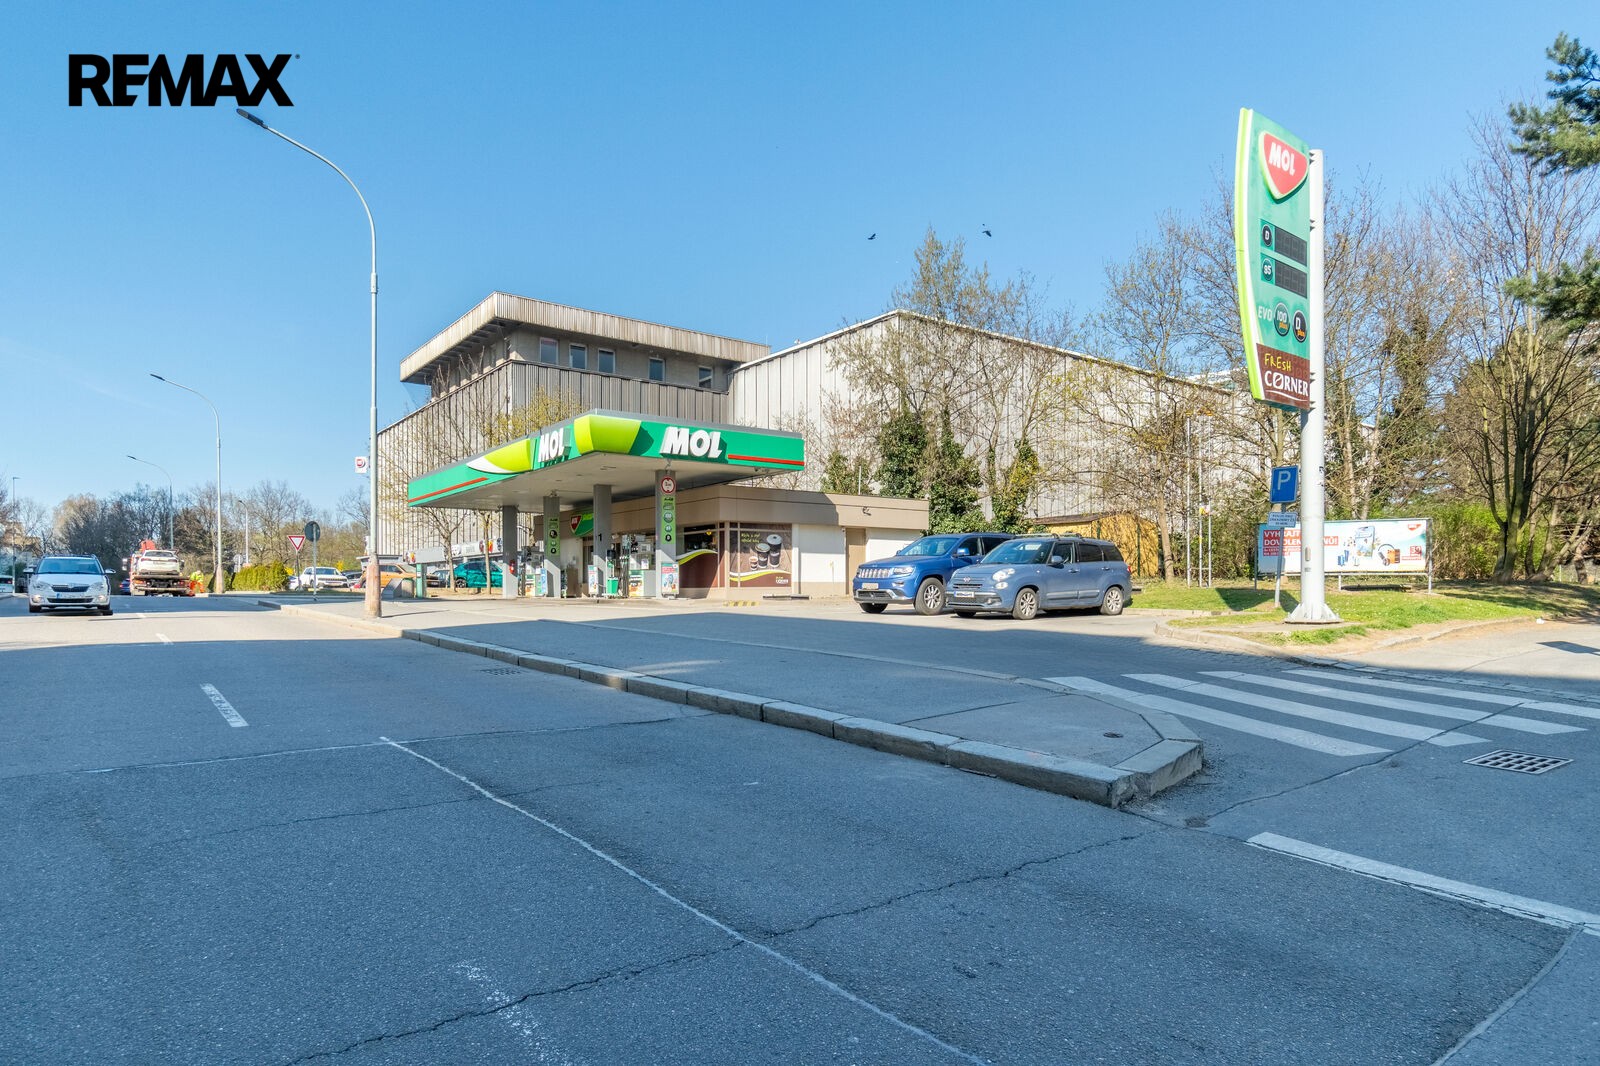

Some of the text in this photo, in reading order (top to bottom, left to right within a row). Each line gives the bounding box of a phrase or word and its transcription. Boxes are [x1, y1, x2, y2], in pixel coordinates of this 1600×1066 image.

[1269, 142, 1296, 176] MOL
[1264, 230, 1270, 241] D
[1263, 264, 1272, 276] 95
[1258, 305, 1301, 330] EVO 100 D
[1264, 353, 1292, 372] FRESH
[537, 428, 565, 463] MOL
[660, 426, 722, 459] MOL
[1277, 470, 1291, 490] P
